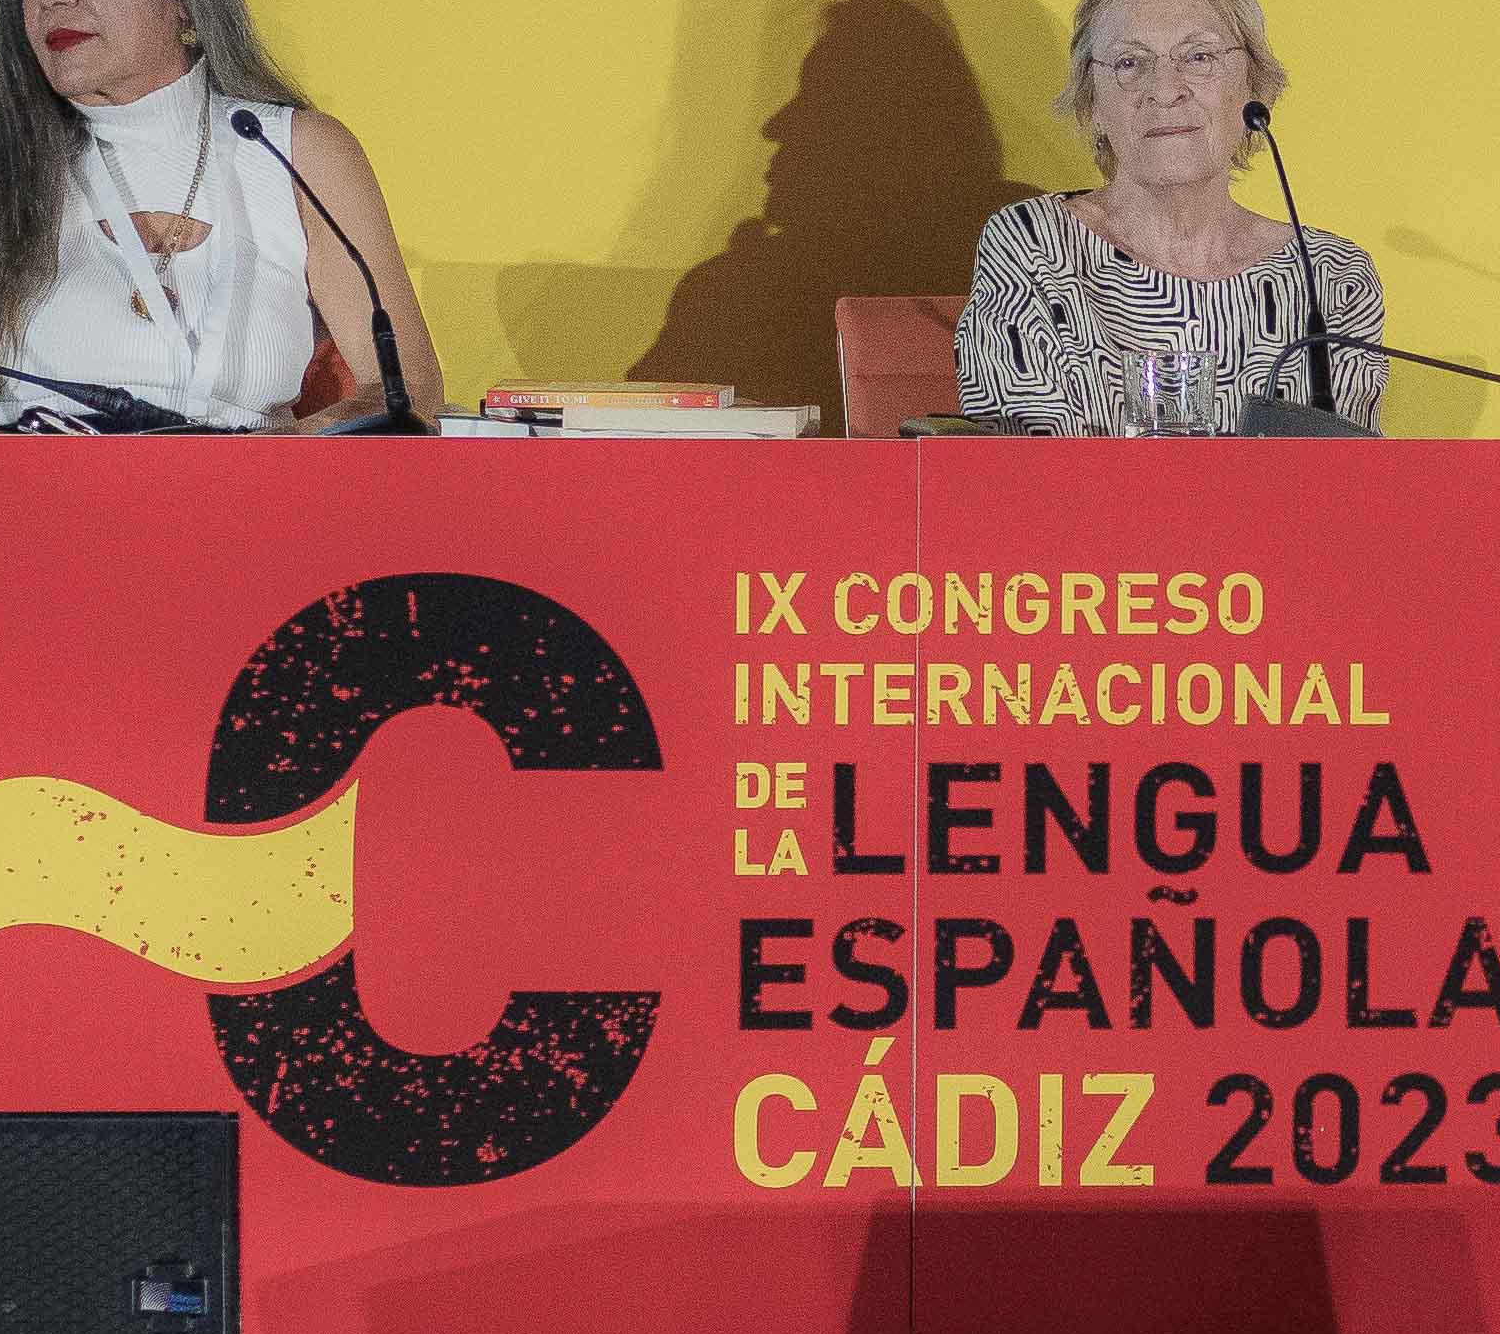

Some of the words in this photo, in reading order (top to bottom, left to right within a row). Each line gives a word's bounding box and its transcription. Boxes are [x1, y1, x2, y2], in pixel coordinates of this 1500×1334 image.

[735, 571, 807, 635] IX
[833, 571, 1265, 636] CONGRESO
[733, 662, 1391, 727] INTERNACIONAL
[734, 762, 808, 810] DE
[831, 761, 1432, 876] LENGUA
[733, 828, 808, 875] LA
[732, 1037, 1157, 1189] CÁDIZ
